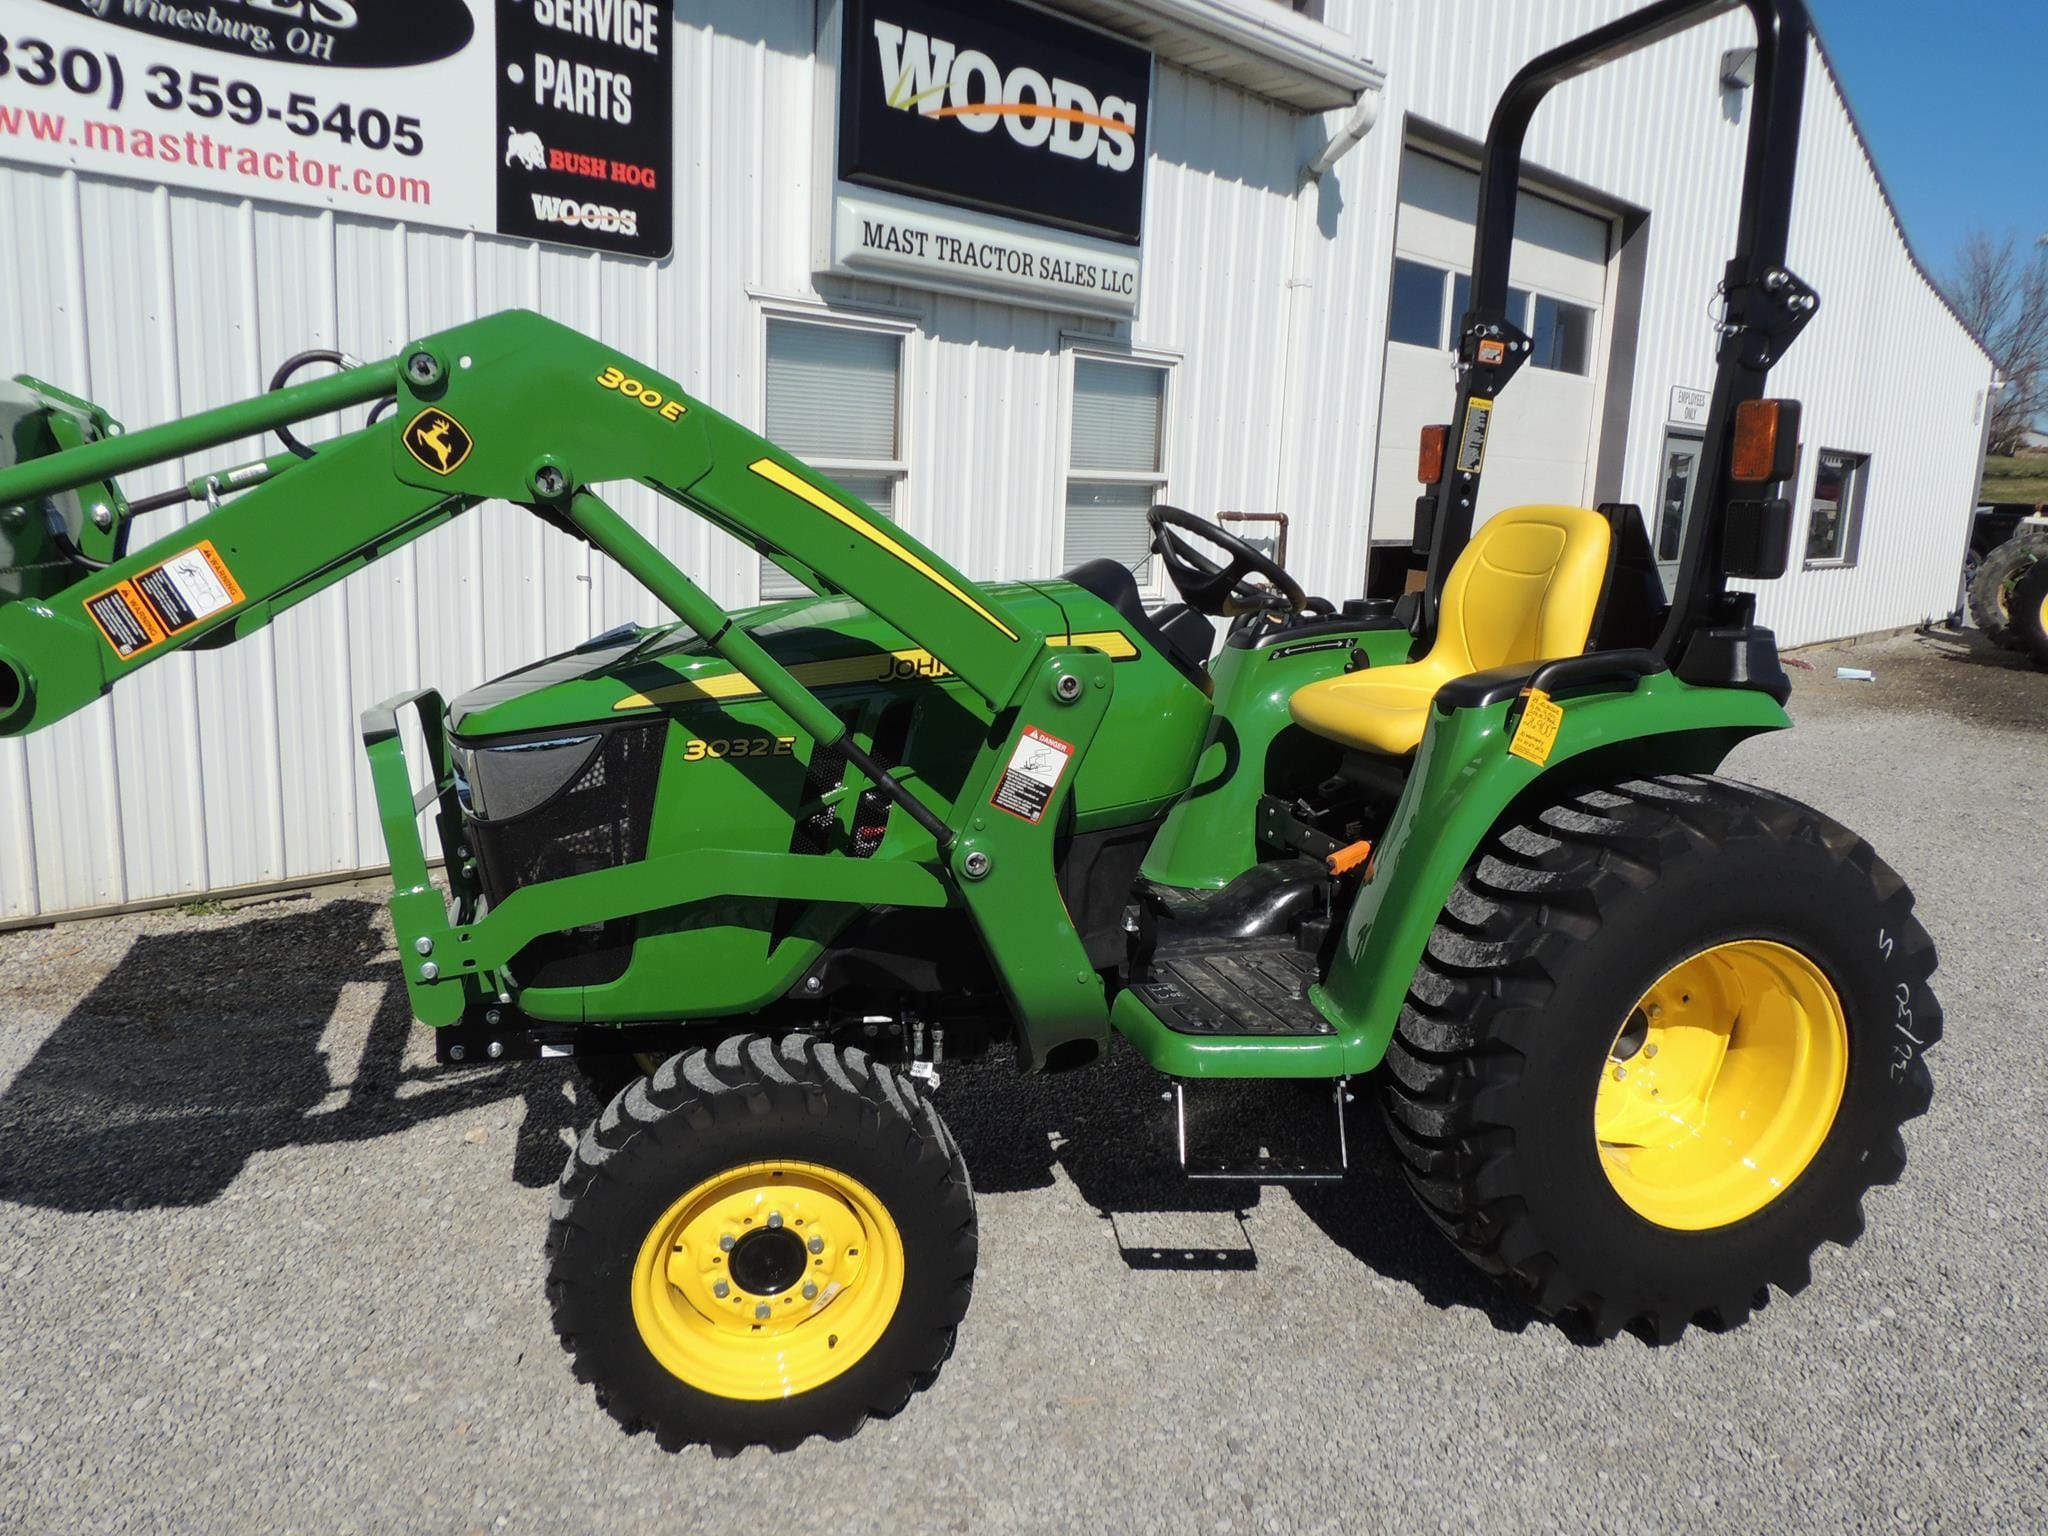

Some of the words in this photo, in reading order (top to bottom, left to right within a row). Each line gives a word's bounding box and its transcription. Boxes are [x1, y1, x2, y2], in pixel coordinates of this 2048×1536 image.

[285, 27, 336, 62] OH
[0, 32, 125, 111] 30)
[144, 63, 425, 157] 359-5405
[534, 53, 632, 125] PARTS
[874, 19, 1137, 172] WOODS
[549, 149, 607, 178] BUSH
[611, 160, 656, 189] HOG
[531, 193, 638, 237] WOODS
[862, 221, 929, 257] MAST
[935, 235, 1034, 278] TRACTOR
[1039, 256, 1097, 289] SALES
[1101, 268, 1134, 295] LLC
[595, 366, 688, 422] 300E
[1677, 390, 1706, 408] EMPLOYEES
[1684, 406, 1697, 420] ONLY
[209, 557, 238, 596] WARNING
[129, 599, 158, 637] WARNING
[682, 736, 796, 762] 3032E
[1038, 734, 1068, 752] DANGER
